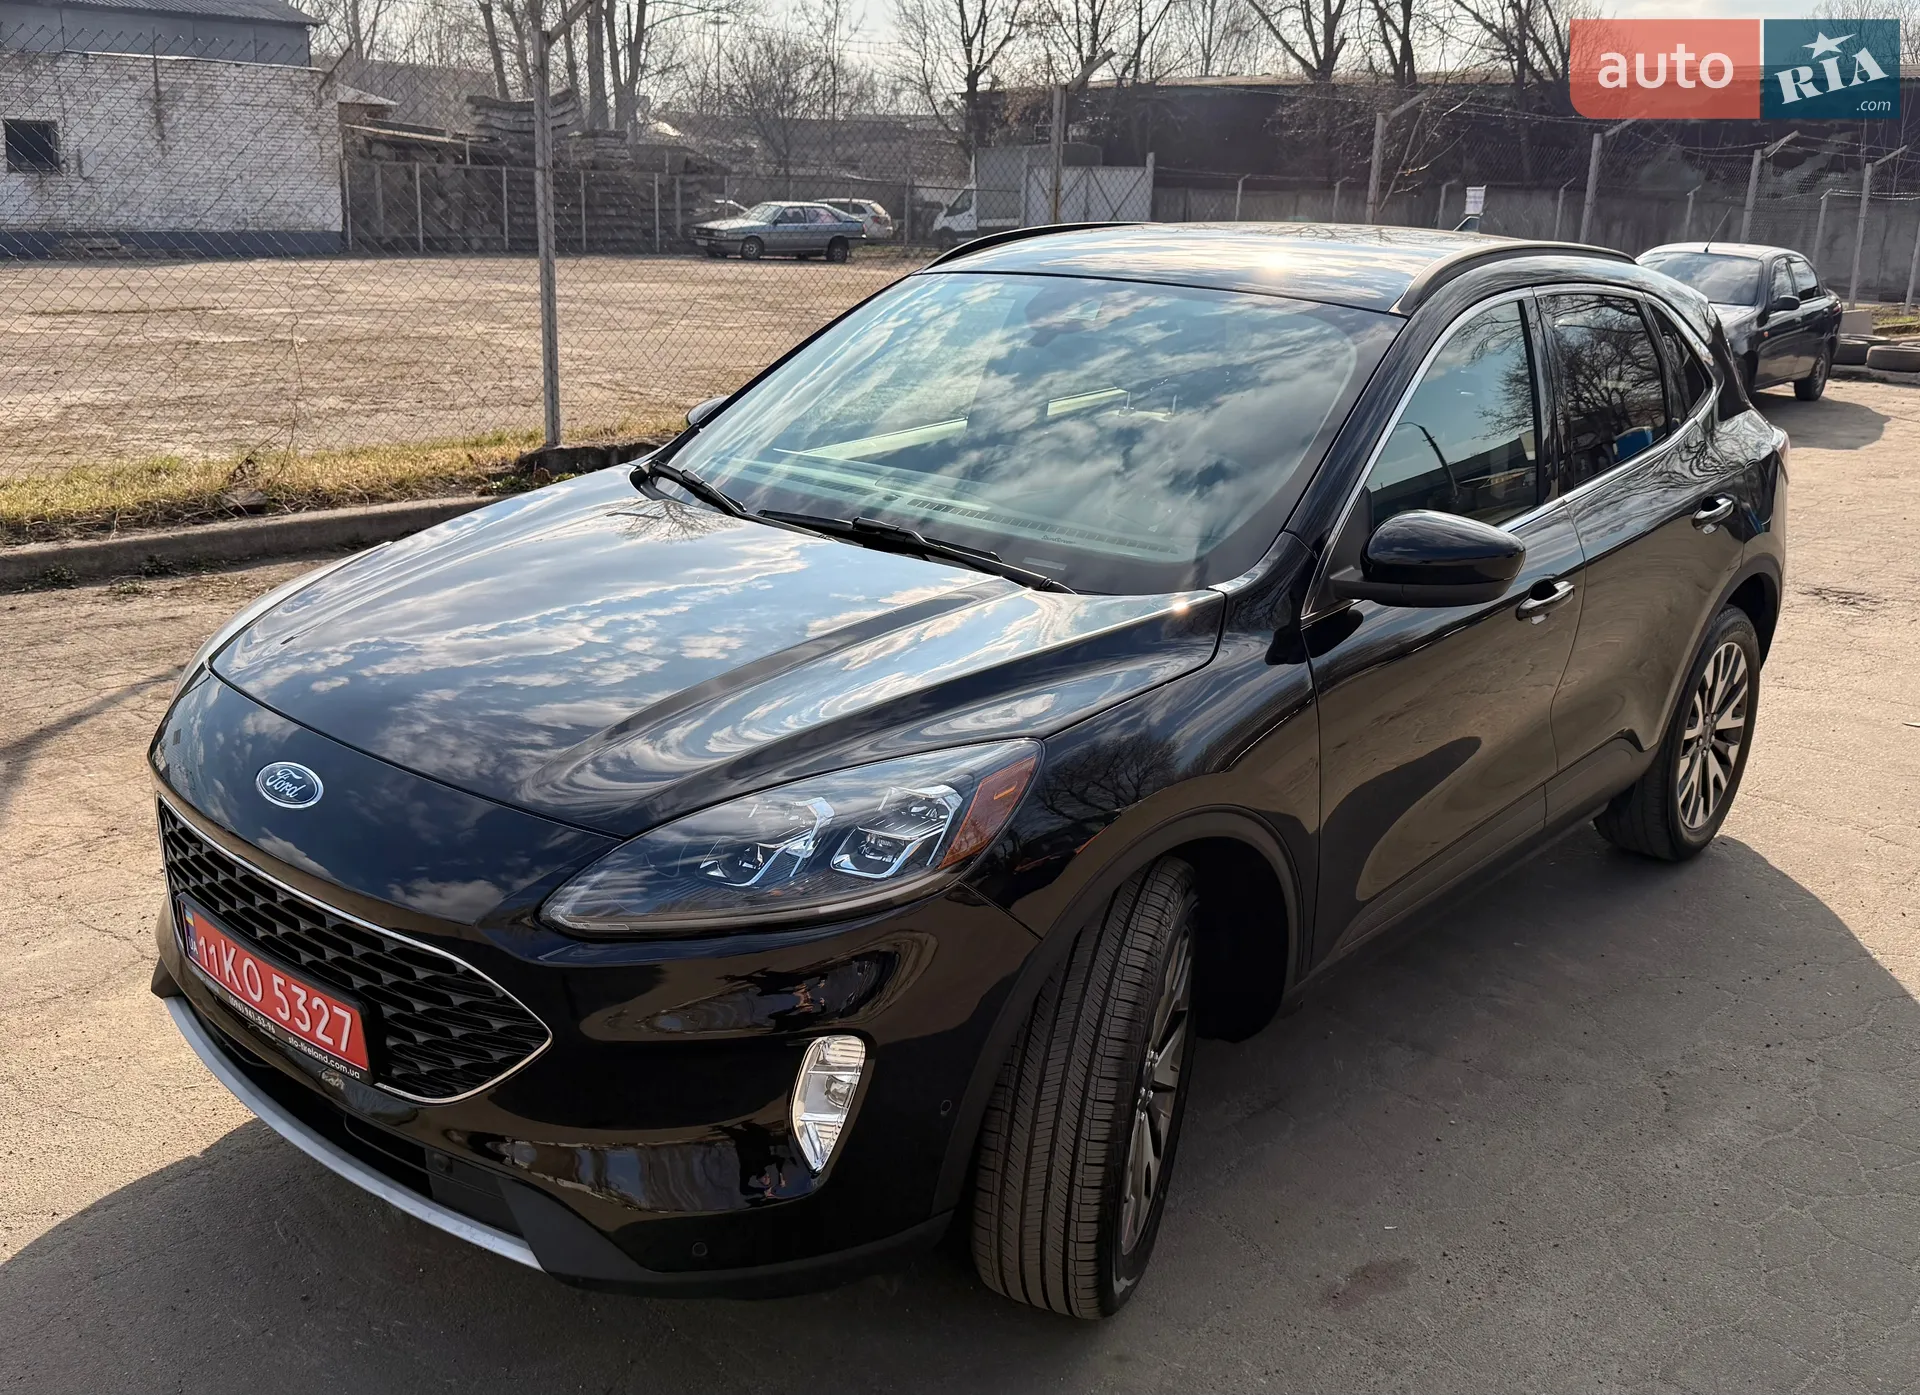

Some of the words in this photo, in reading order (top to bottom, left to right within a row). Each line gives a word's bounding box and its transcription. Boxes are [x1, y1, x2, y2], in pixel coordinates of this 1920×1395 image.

[266, 768, 306, 798] Ford
[188, 936, 199, 955] UA
[199, 936, 263, 1003] 11KO
[272, 973, 352, 1052] 5327
